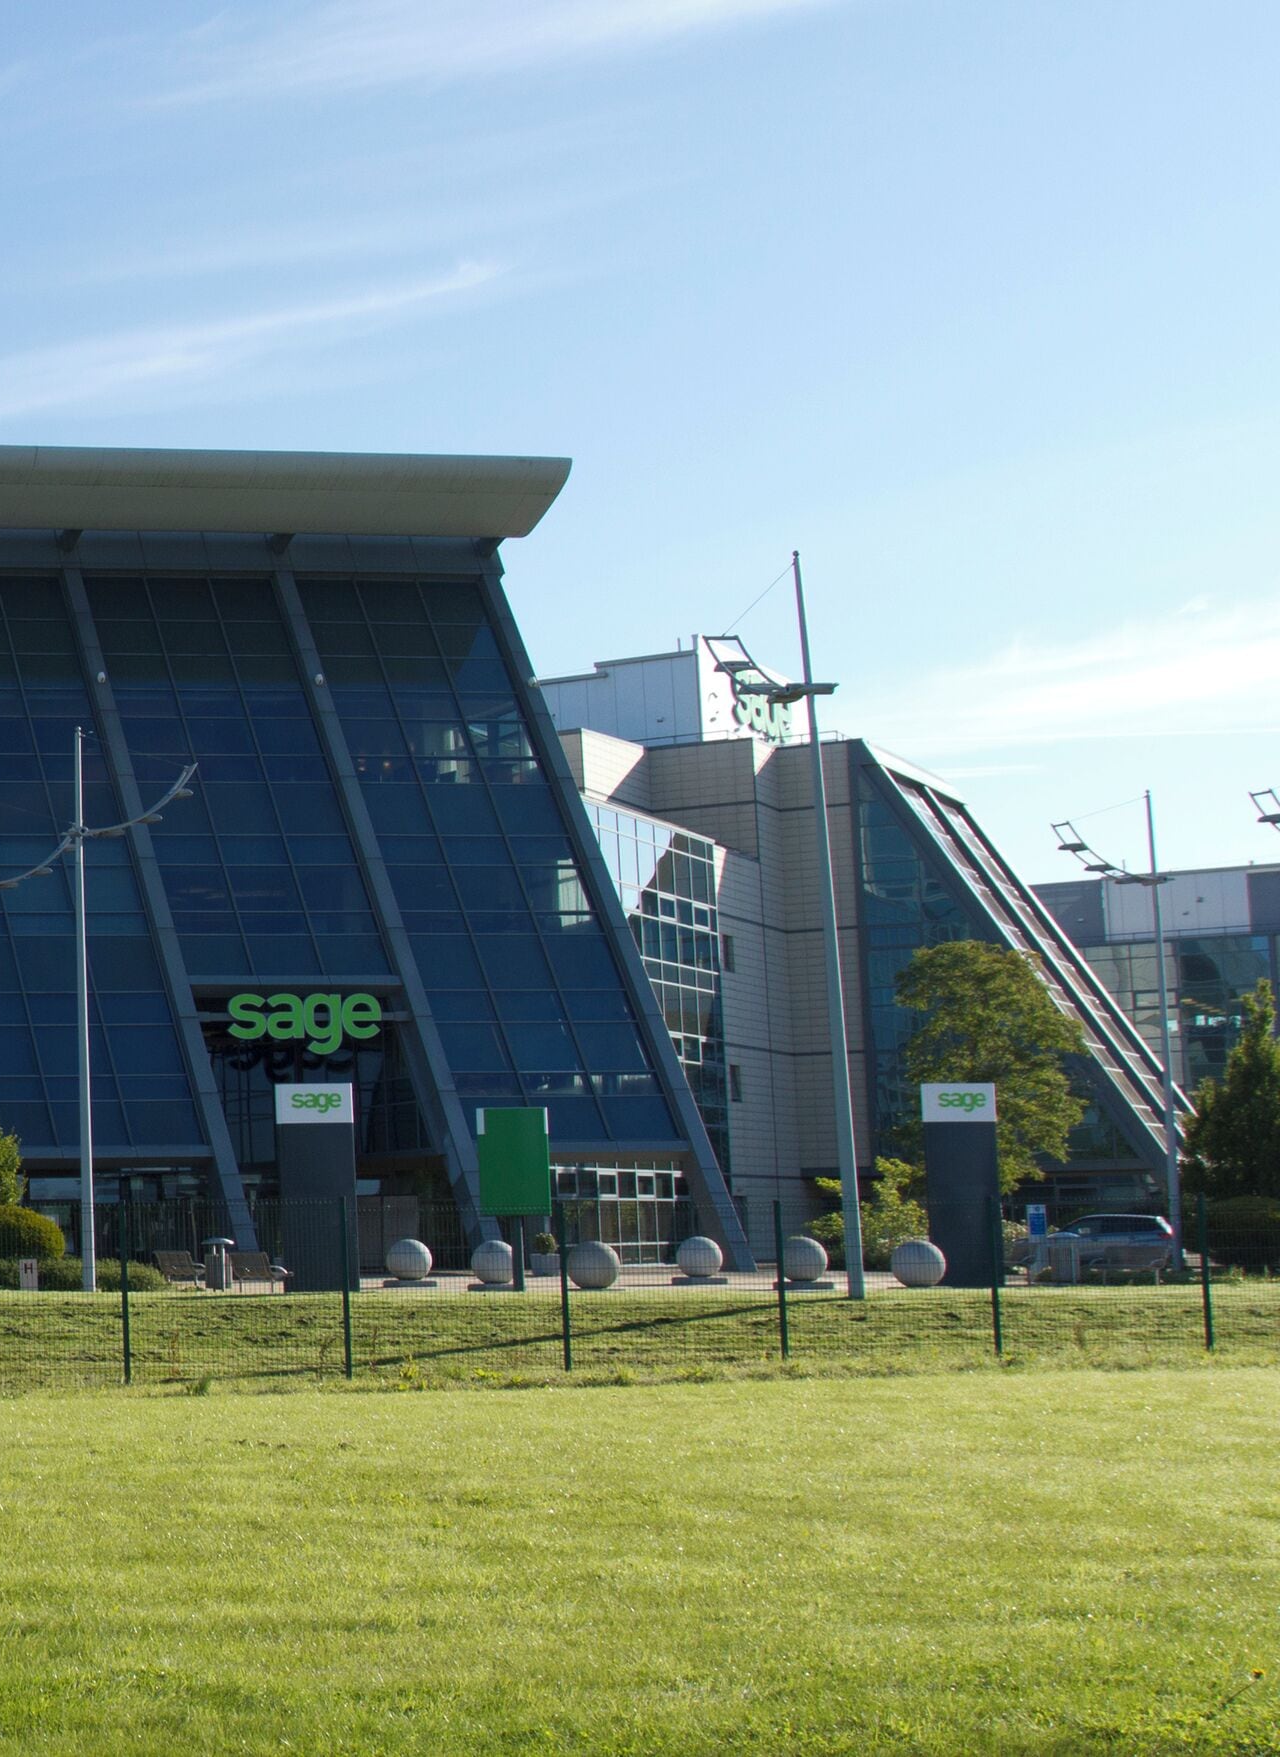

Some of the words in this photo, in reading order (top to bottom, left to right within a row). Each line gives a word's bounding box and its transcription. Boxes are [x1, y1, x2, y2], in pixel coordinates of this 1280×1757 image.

[228, 992, 382, 1055] sage
[291, 1092, 342, 1114] sage
[938, 1092, 986, 1112] sage
